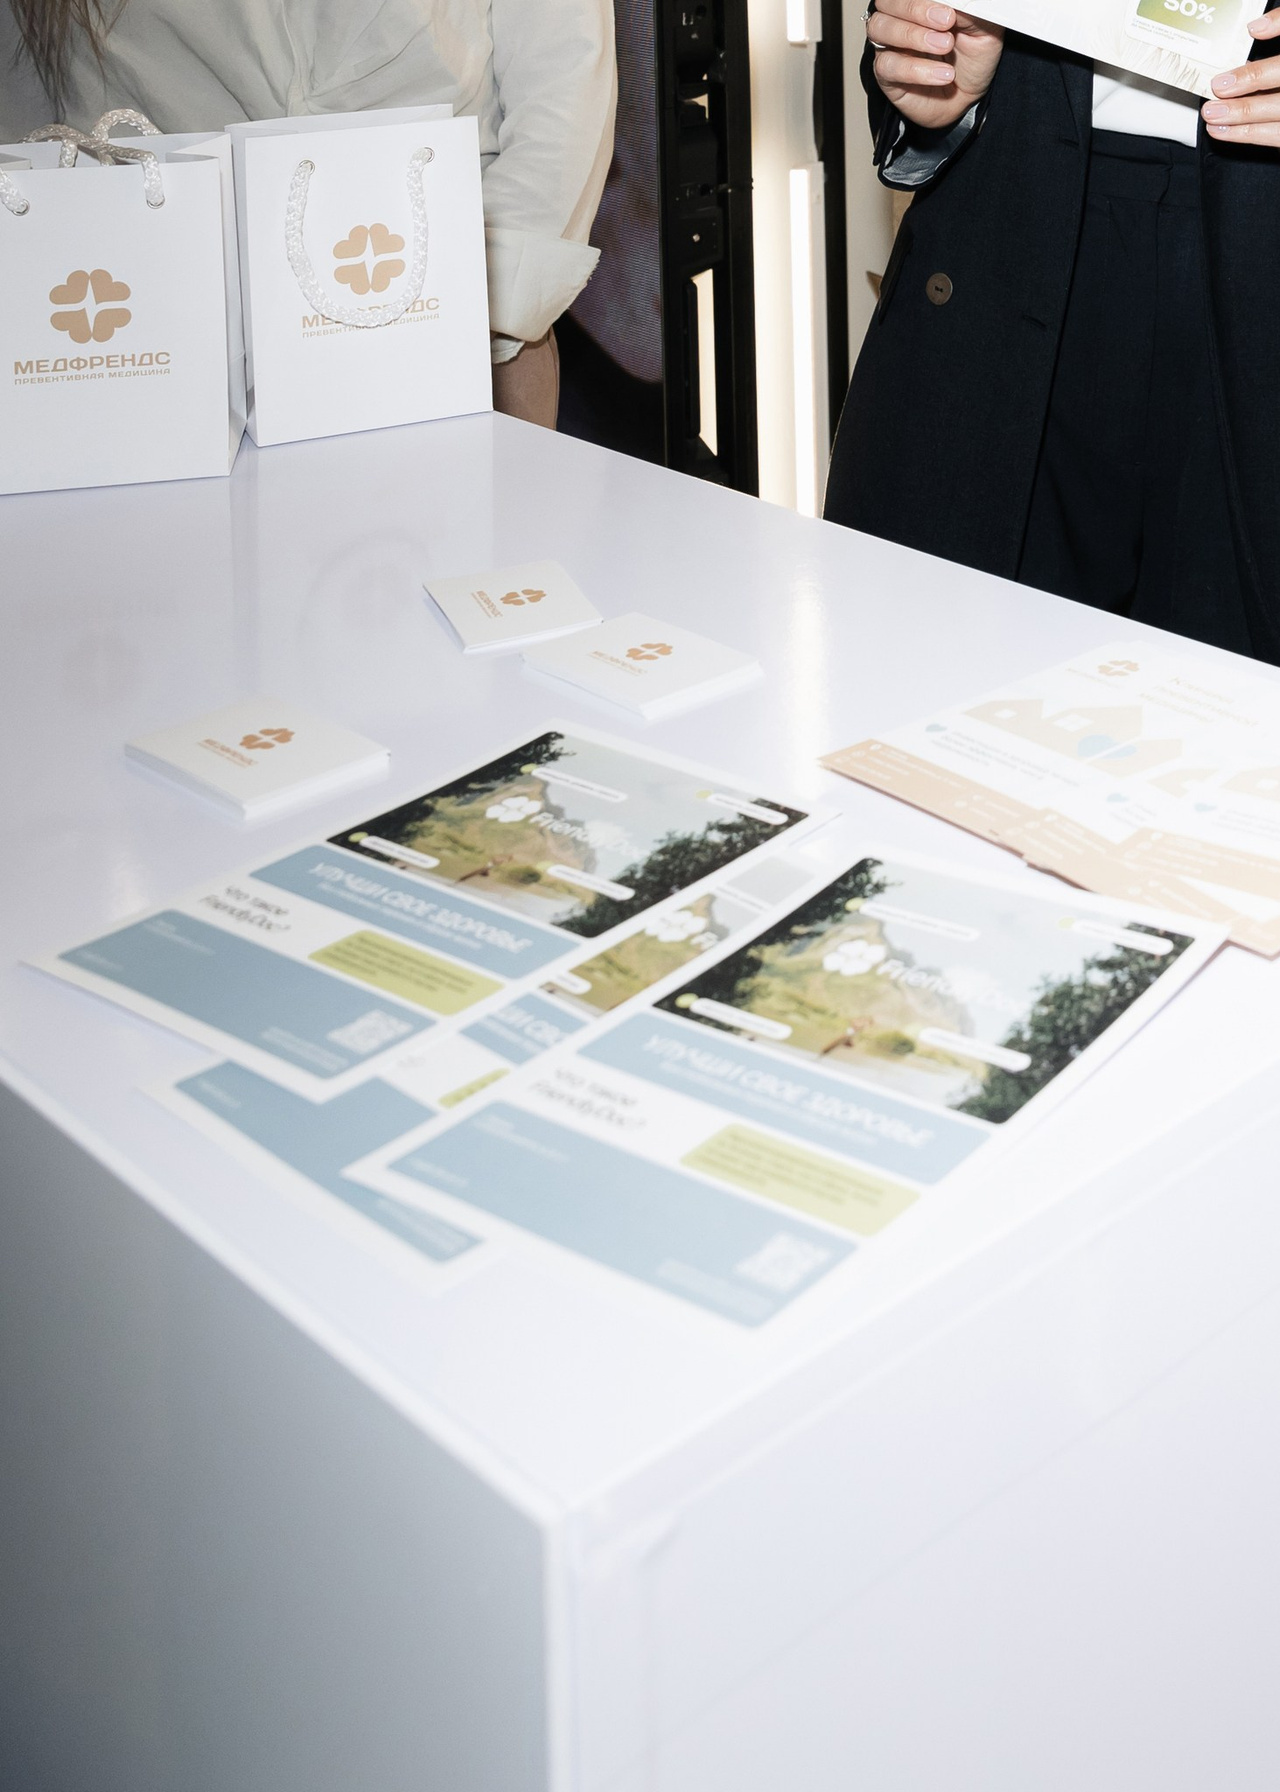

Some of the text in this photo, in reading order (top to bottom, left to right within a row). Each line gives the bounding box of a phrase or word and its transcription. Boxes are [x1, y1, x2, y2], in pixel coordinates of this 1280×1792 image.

[14, 351, 171, 376] МЕДФРЕНДС
[14, 367, 171, 385] ПРЕВЕНТИВНАЯ МЕДИЦИНА
